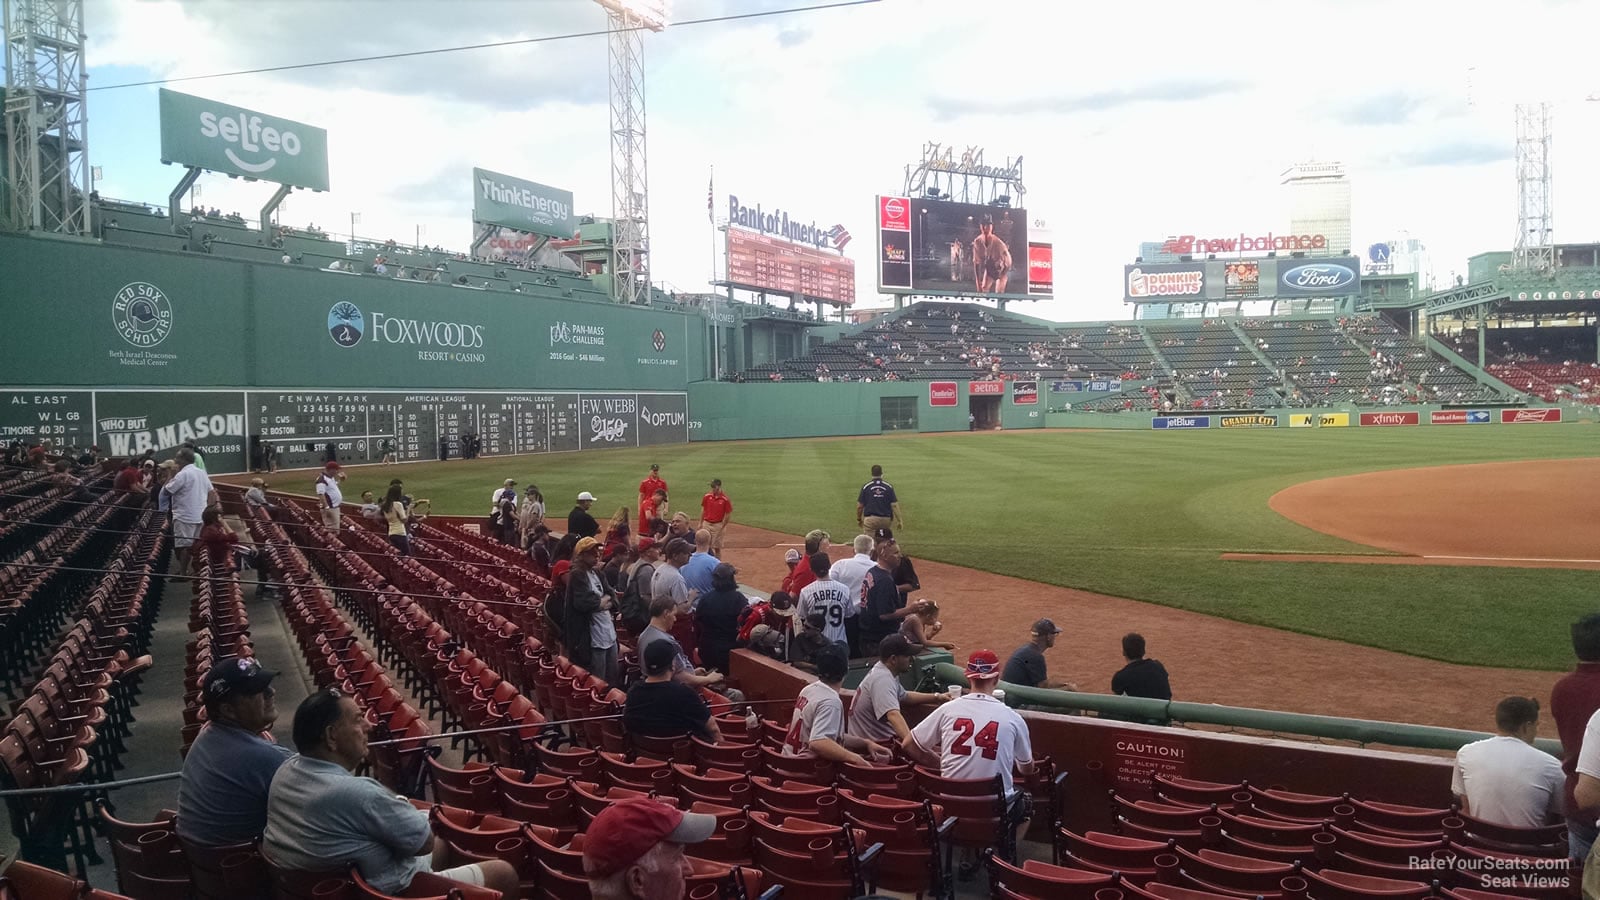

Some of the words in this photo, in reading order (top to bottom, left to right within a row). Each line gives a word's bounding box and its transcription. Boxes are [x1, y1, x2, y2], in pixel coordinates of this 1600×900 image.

[200, 111, 301, 156] selfeo
[480, 179, 568, 219] ThinkEnergy
[729, 194, 766, 232] Bank
[765, 208, 781, 233] of
[781, 211, 828, 247] America
[1196, 238, 1237, 253] new
[1240, 232, 1326, 251] balance
[1149, 273, 1201, 284] DUNKIN'
[1297, 267, 1340, 287] Ford
[1149, 284, 1199, 294] DONUTS
[116, 287, 135, 311] RED
[138, 285, 161, 302] SOX
[119, 310, 170, 344] SCHOLARS
[572, 324, 604, 335] PAN-MASS
[572, 336, 604, 346] CHALLENGE
[109, 350, 124, 358] Beth
[146, 351, 177, 359] Deaconess
[418, 351, 448, 360] RESORT
[456, 353, 485, 362] CASINO
[550, 352, 562, 360] 2016
[120, 358, 146, 366] Medical
[975, 384, 998, 392] aetna
[12, 396, 28, 404] AL
[34, 396, 68, 404] EAST
[582, 400, 601, 414] F.W.
[604, 399, 635, 413] WEBB
[38, 412, 50, 420] W
[56, 412, 62, 420] L
[66, 412, 80, 420] GB
[652, 413, 684, 426] OPTUM
[1222, 416, 1256, 426] GRANITE
[1258, 416, 1275, 426] CITY
[1373, 414, 1405, 425] xfinity
[100, 419, 124, 431] WHO
[127, 418, 147, 429] BUT
[1168, 418, 1196, 428] jetBlue
[40, 426, 50, 434] 40
[54, 426, 64, 434] 30
[156, 414, 244, 450] MASON
[56, 438, 64, 446] 31
[221, 444, 240, 452] 1898
[813, 590, 843, 602] ABREU
[814, 604, 842, 627] 79
[951, 718, 999, 760] 24
[1116, 742, 1184, 758] CAUTION!
